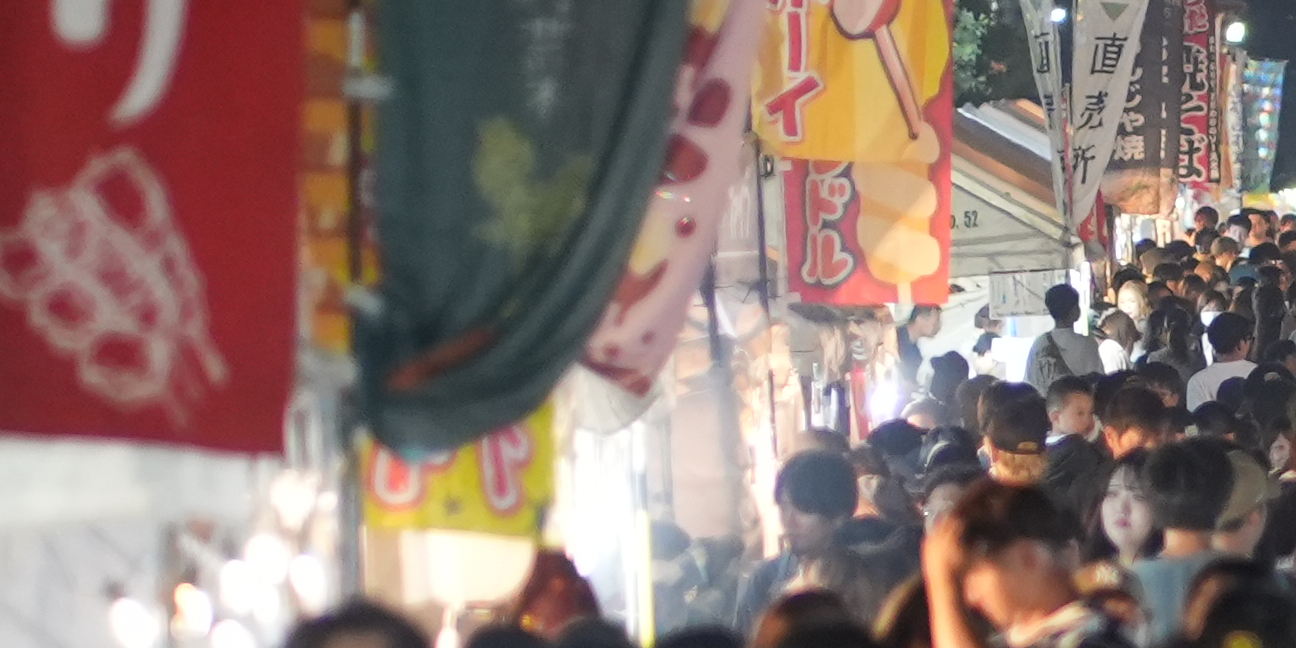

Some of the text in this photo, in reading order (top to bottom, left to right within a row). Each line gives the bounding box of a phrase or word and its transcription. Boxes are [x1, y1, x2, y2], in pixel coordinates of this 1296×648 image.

[1072, 33, 1129, 185] 直売所
[964, 210, 978, 229] 52
